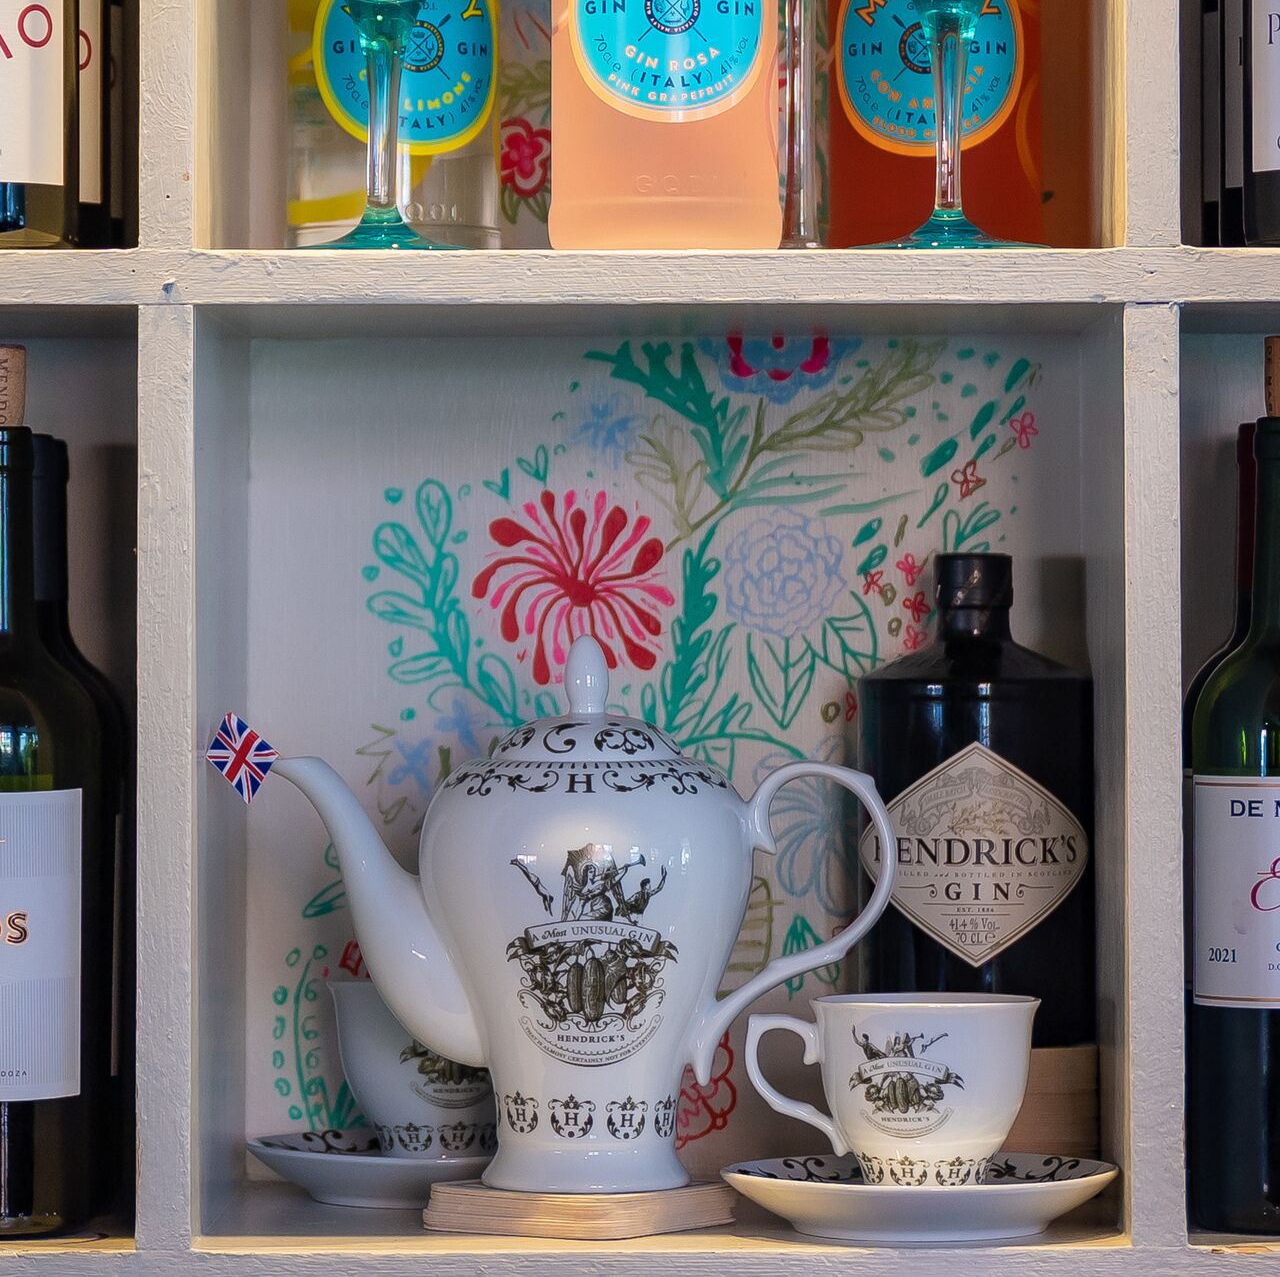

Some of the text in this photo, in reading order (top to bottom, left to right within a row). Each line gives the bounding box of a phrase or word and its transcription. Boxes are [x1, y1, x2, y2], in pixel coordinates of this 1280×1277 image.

[585, 0, 754, 16] GIN GIN
[457, 41, 488, 57] GIN
[849, 41, 1007, 57] GIN GIN
[624, 45, 720, 72] GIN ROSA
[608, 73, 737, 102] PINK GRAPEFRUIT
[871, 69, 902, 103] CON
[565, 773, 596, 793] H
[1230, 799, 1264, 817] DE
[944, 882, 1011, 901] GIN
[532, 925, 654, 944] A Most UNUSUAL GIN
[1208, 947, 1237, 964] 2021
[557, 1034, 625, 1044] HENDRICK'S
[568, 1055, 602, 1063] CERTAINLY
